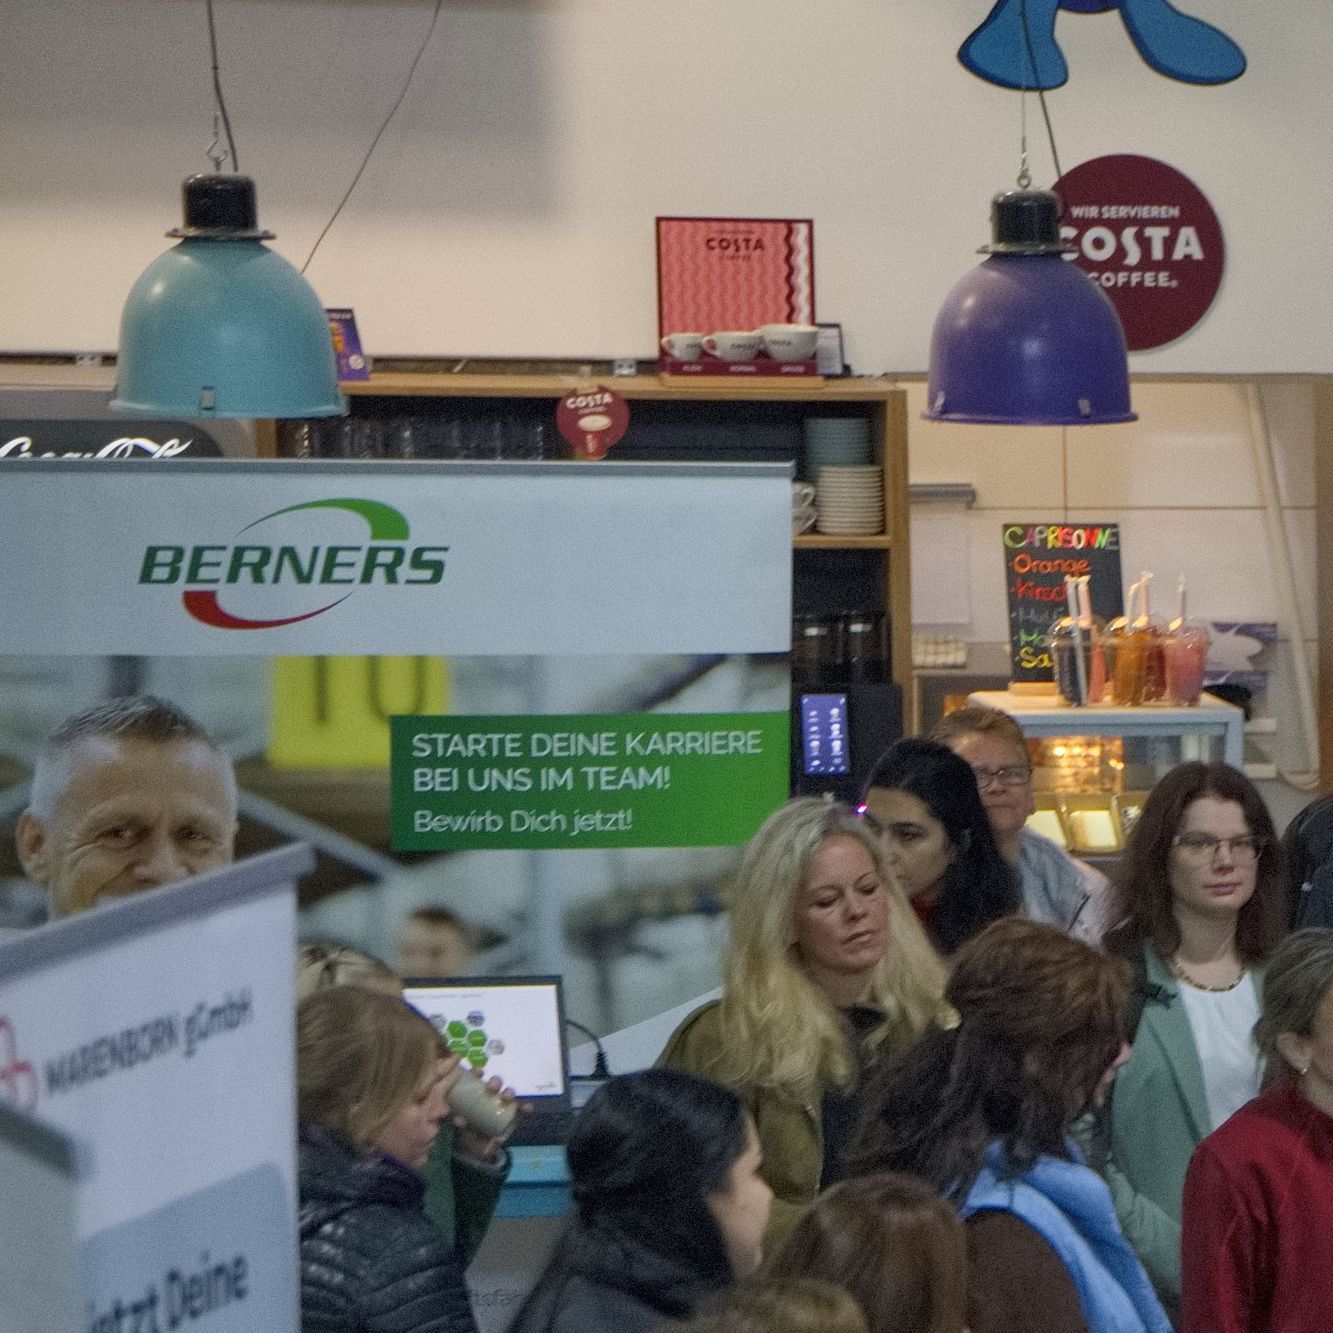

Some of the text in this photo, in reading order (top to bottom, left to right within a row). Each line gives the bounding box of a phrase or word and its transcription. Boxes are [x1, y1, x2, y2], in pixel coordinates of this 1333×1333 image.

[1071, 205, 1180, 219] WIR SERVIEREN
[705, 236, 765, 252] COSTA
[566, 392, 614, 410] COSTA
[138, 545, 449, 585] BERNERS
[411, 729, 764, 758] STARTE DEINE KARRIERE
[413, 765, 671, 792] BEI UNS IM TEAM!
[413, 808, 634, 836] Bewirb Dich jetzt!
[165, 1249, 250, 1332] Deine
